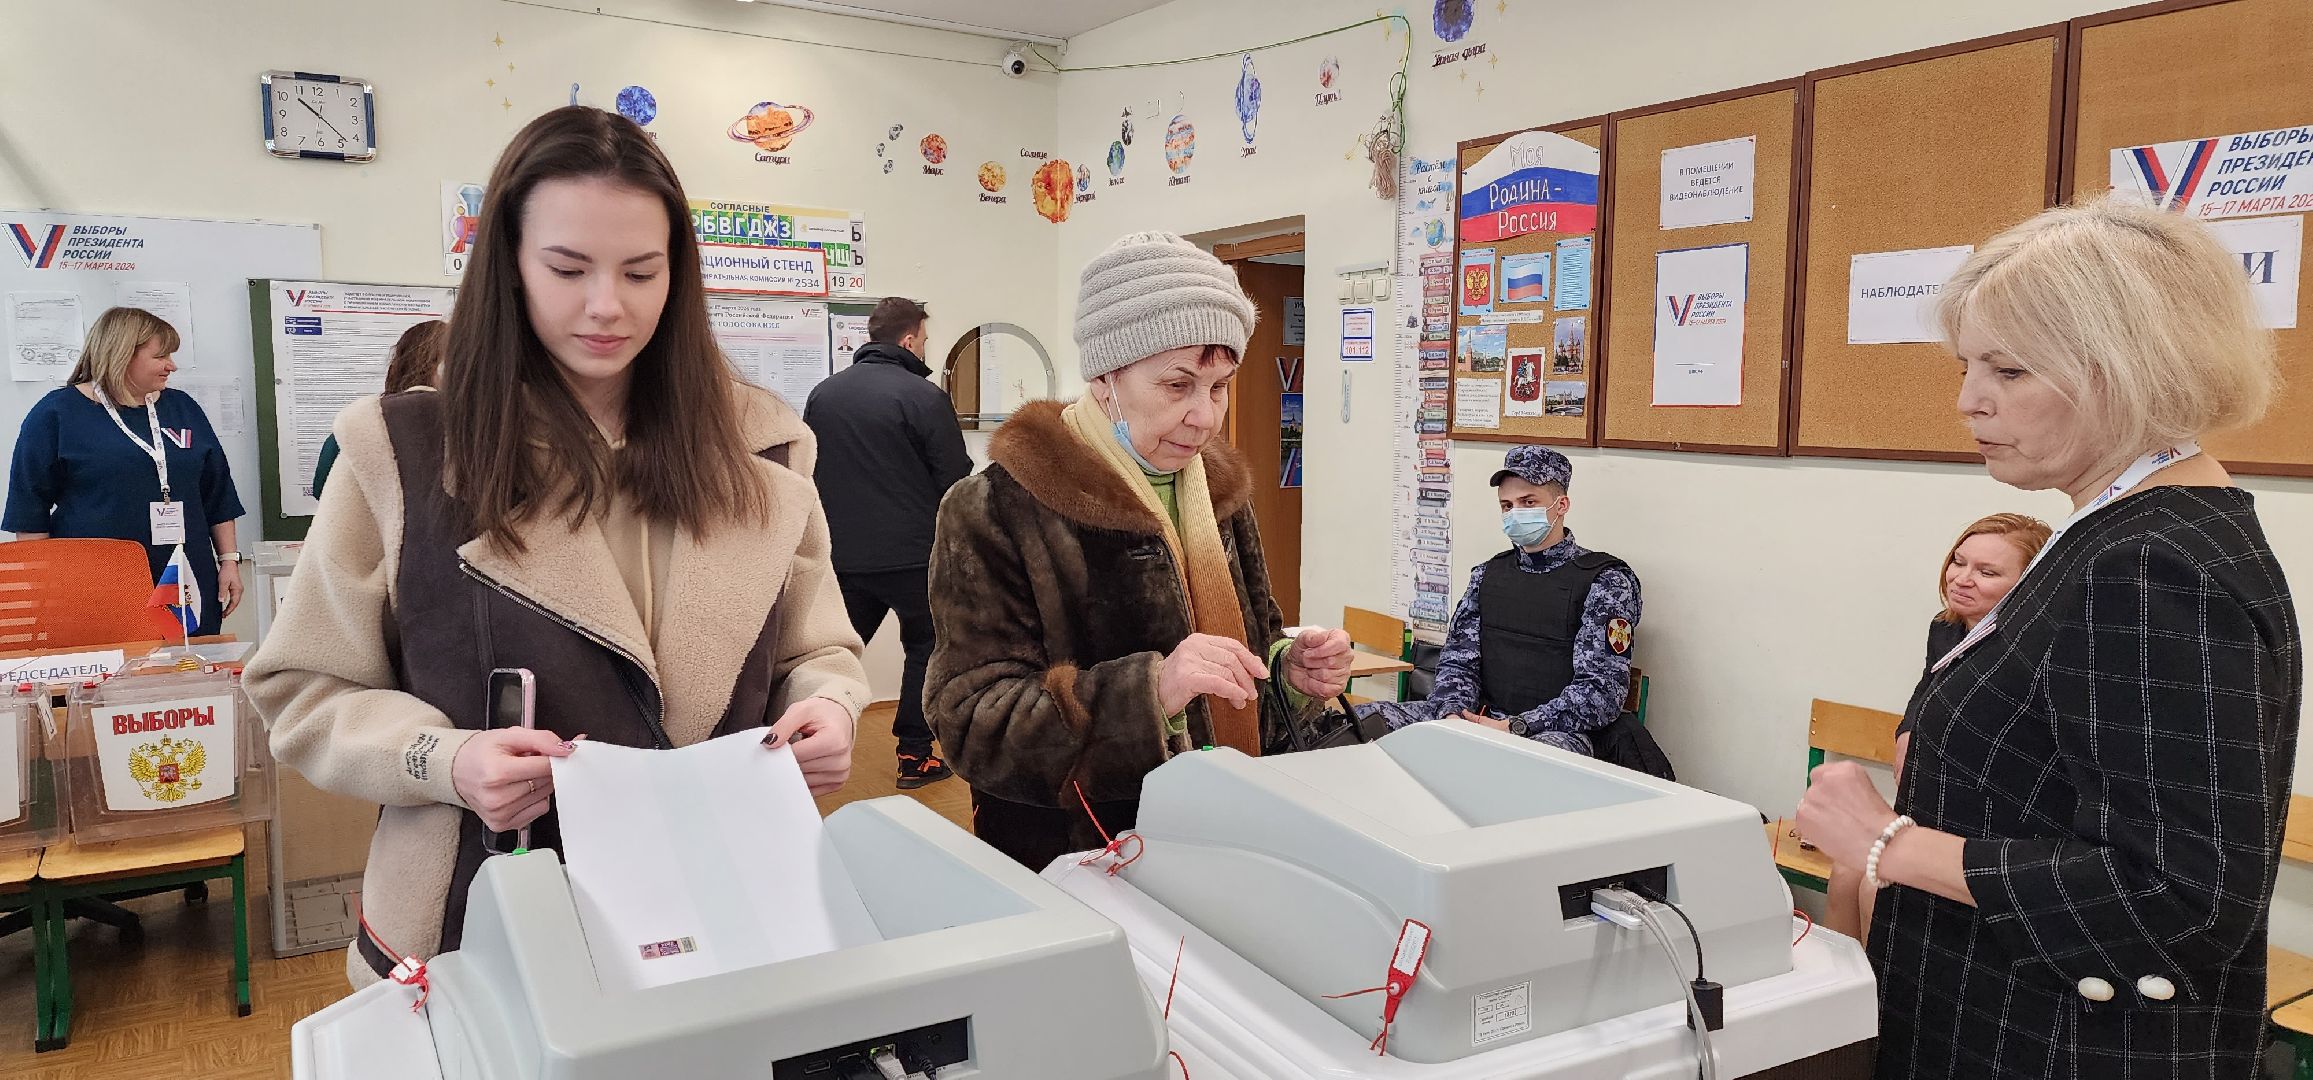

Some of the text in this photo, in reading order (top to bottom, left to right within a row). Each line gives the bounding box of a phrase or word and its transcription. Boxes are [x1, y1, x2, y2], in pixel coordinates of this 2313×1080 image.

[295, 86, 303, 95] 11
[312, 87, 324, 96] 12
[336, 89, 340, 99] 1
[277, 91, 288, 102] 10
[350, 97, 357, 107] 2
[279, 109, 287, 119] 9
[352, 116, 359, 125] 3
[280, 127, 288, 137] 8
[298, 136, 306, 146] 7
[318, 137, 325, 147] 6
[352, 134, 360, 142] 4
[337, 139, 345, 149] 5
[754, 152, 791, 165] Сатурн
[1020, 148, 1048, 159] Солнце
[922, 165, 944, 177] Марс
[1685, 162, 1734, 175] ПОМЕЩЕНИИ
[1690, 176, 1721, 187] ВЕДЕТСЯ
[2207, 174, 2287, 197] РОССИИ
[978, 192, 1007, 204] Венера
[1669, 185, 1743, 201] ВИДЕОНАБЛЮДЕНИЕ
[710, 202, 770, 213] СОГЛАСНЫЕ
[2238, 196, 2286, 213] МАРТА
[73, 226, 127, 235] ВЫБОРЫ
[68, 238, 144, 249] ПРЕЗИДЕНТА
[62, 250, 112, 260] РОССИИ
[84, 261, 113, 270] МАРТА
[115, 262, 135, 270] 2024
[702, 256, 813, 274] ЦИОННЫЙ СТЕНД
[795, 278, 820, 288] 2534
[832, 276, 863, 288] 19 20
[1697, 292, 1725, 301] ВЫБОРЫ
[1694, 300, 1733, 309] ПРЕЗИДЕНТА
[1691, 310, 1716, 318] РОССИИ
[112, 706, 215, 736] ВЫБОРЫ
